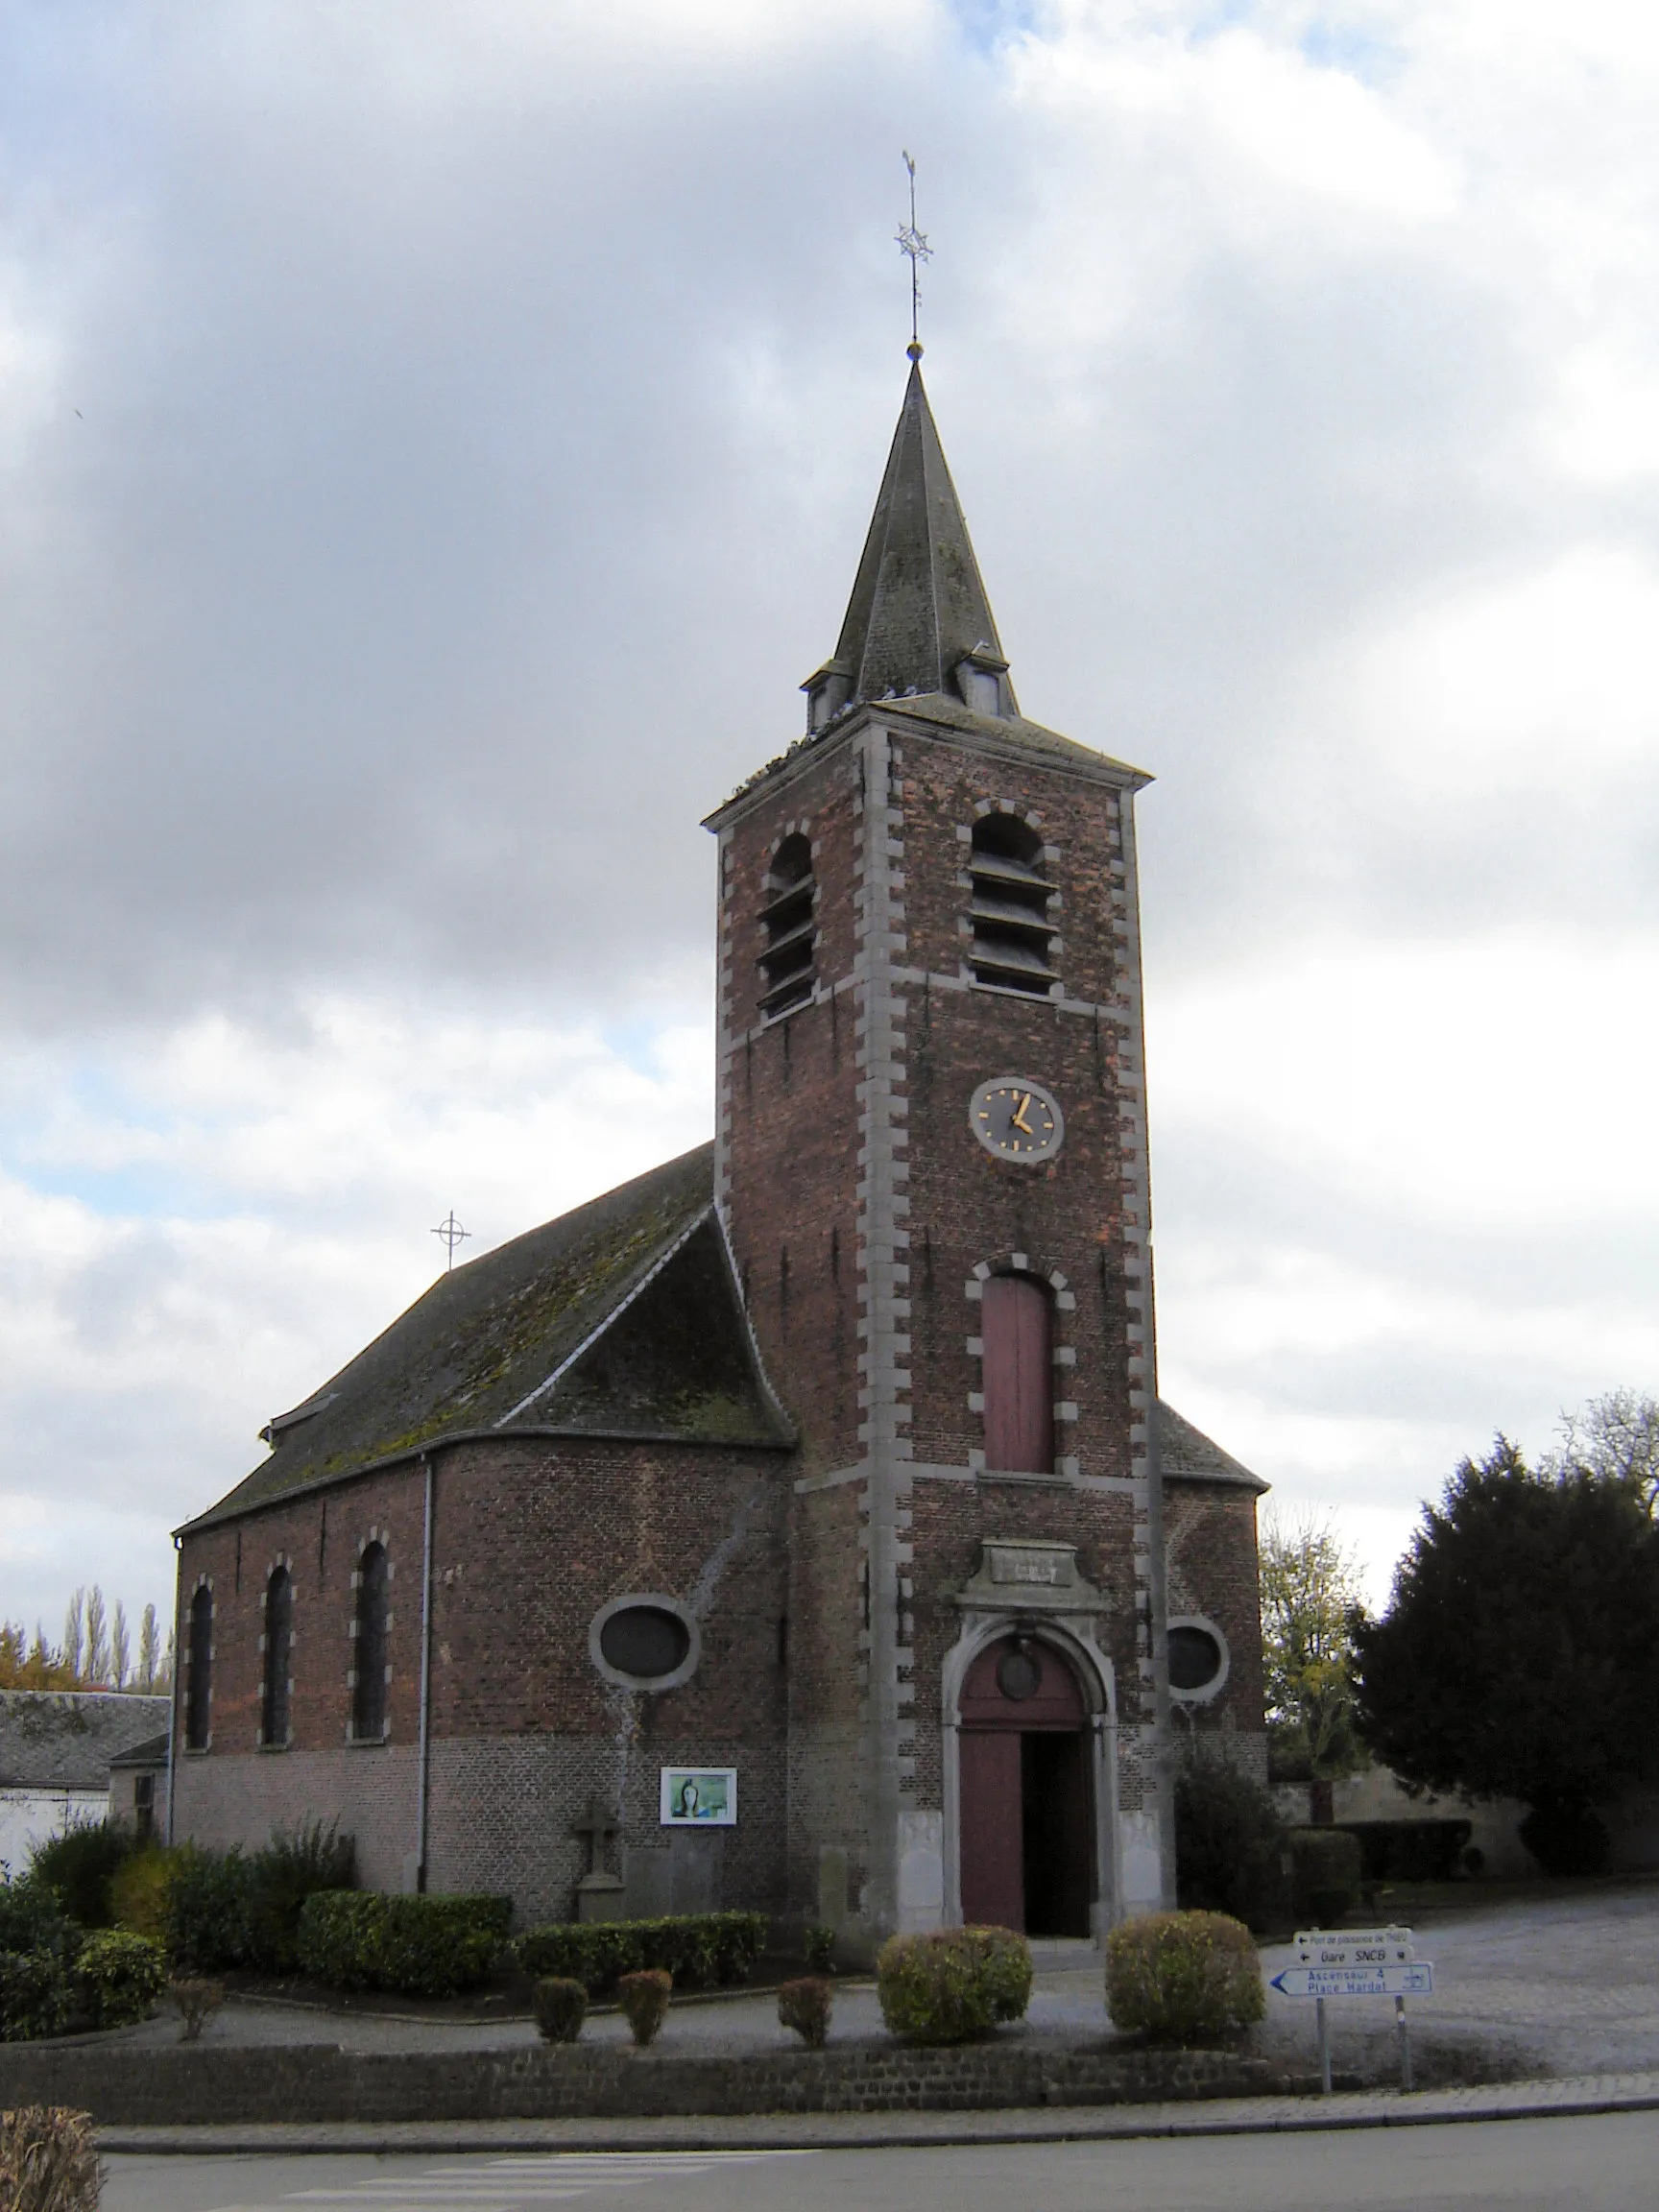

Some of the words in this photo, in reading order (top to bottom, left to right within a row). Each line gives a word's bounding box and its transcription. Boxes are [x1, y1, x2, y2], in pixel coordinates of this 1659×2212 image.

[1326, 1936, 1335, 1944] de
[1337, 1935, 1373, 1945] plaisance
[1375, 1934, 1384, 1943] de
[1321, 1951, 1345, 1962] Gare
[1356, 1950, 1385, 1961] SNCB
[1309, 1970, 1368, 1981] Ascenseur
[1377, 1968, 1383, 1979] 4
